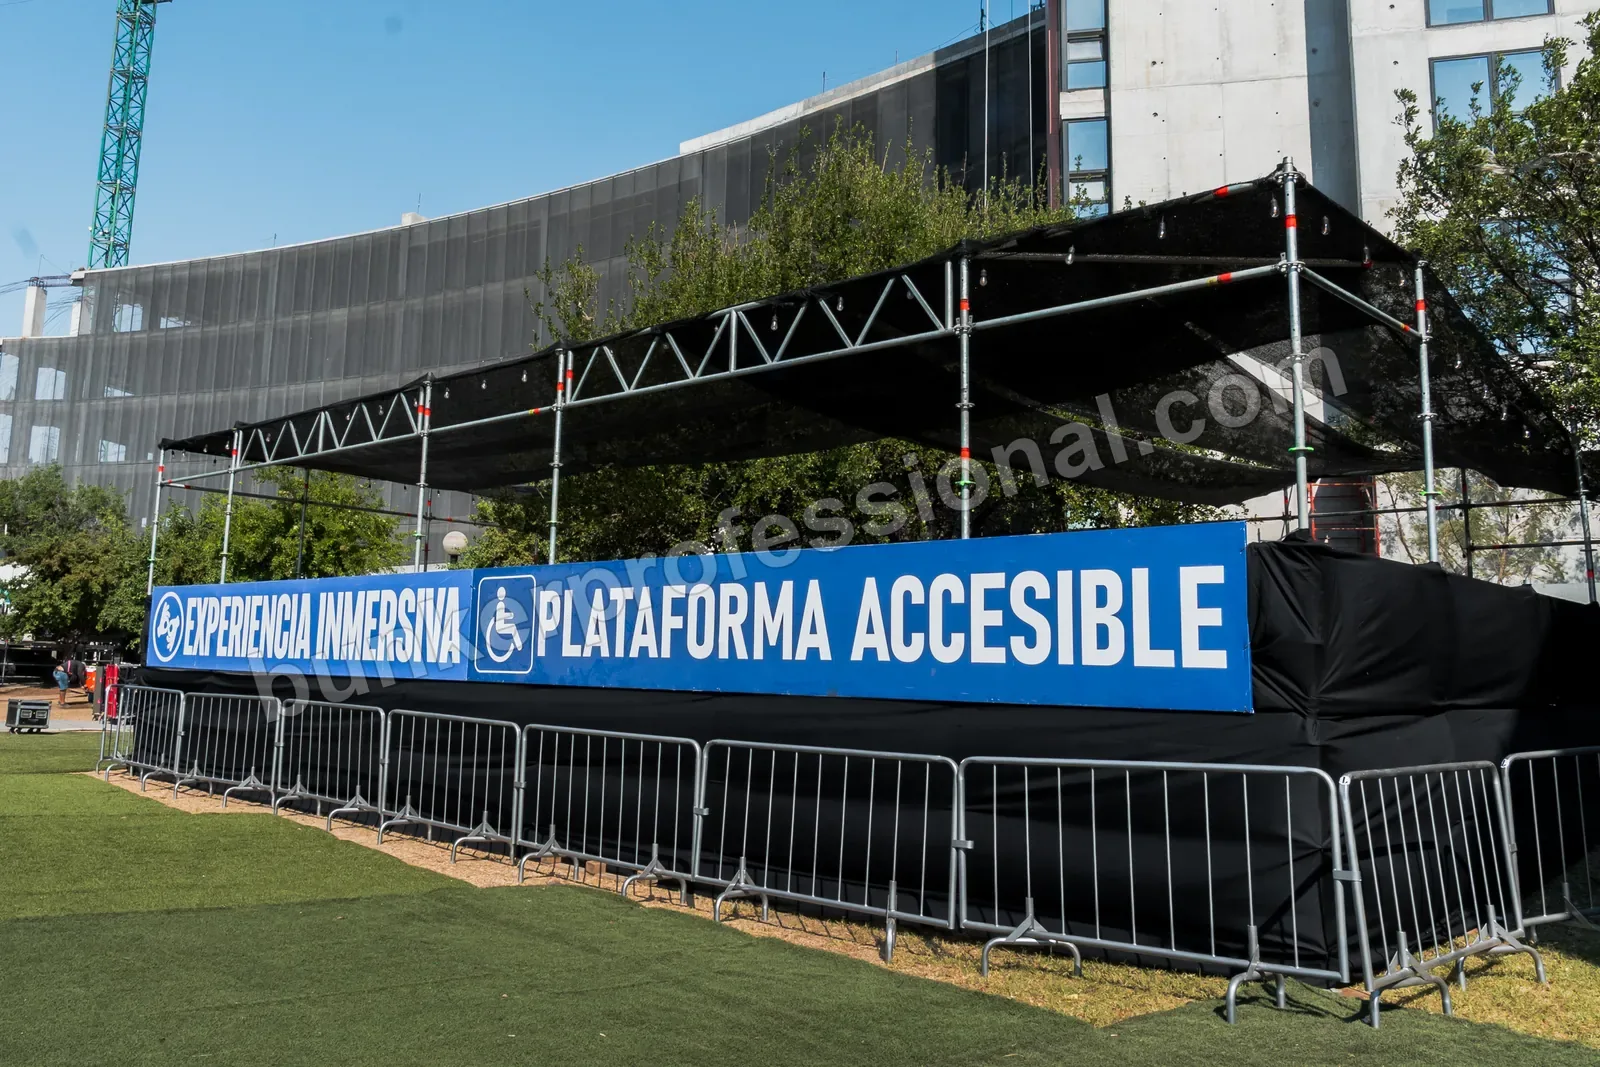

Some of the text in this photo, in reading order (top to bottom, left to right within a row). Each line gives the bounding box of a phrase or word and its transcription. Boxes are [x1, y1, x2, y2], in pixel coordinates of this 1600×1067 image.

[182, 586, 461, 664] EXPERIENCIA INMERSIVA
[537, 565, 1228, 669] PLATAFORMA ACCESIBLE
